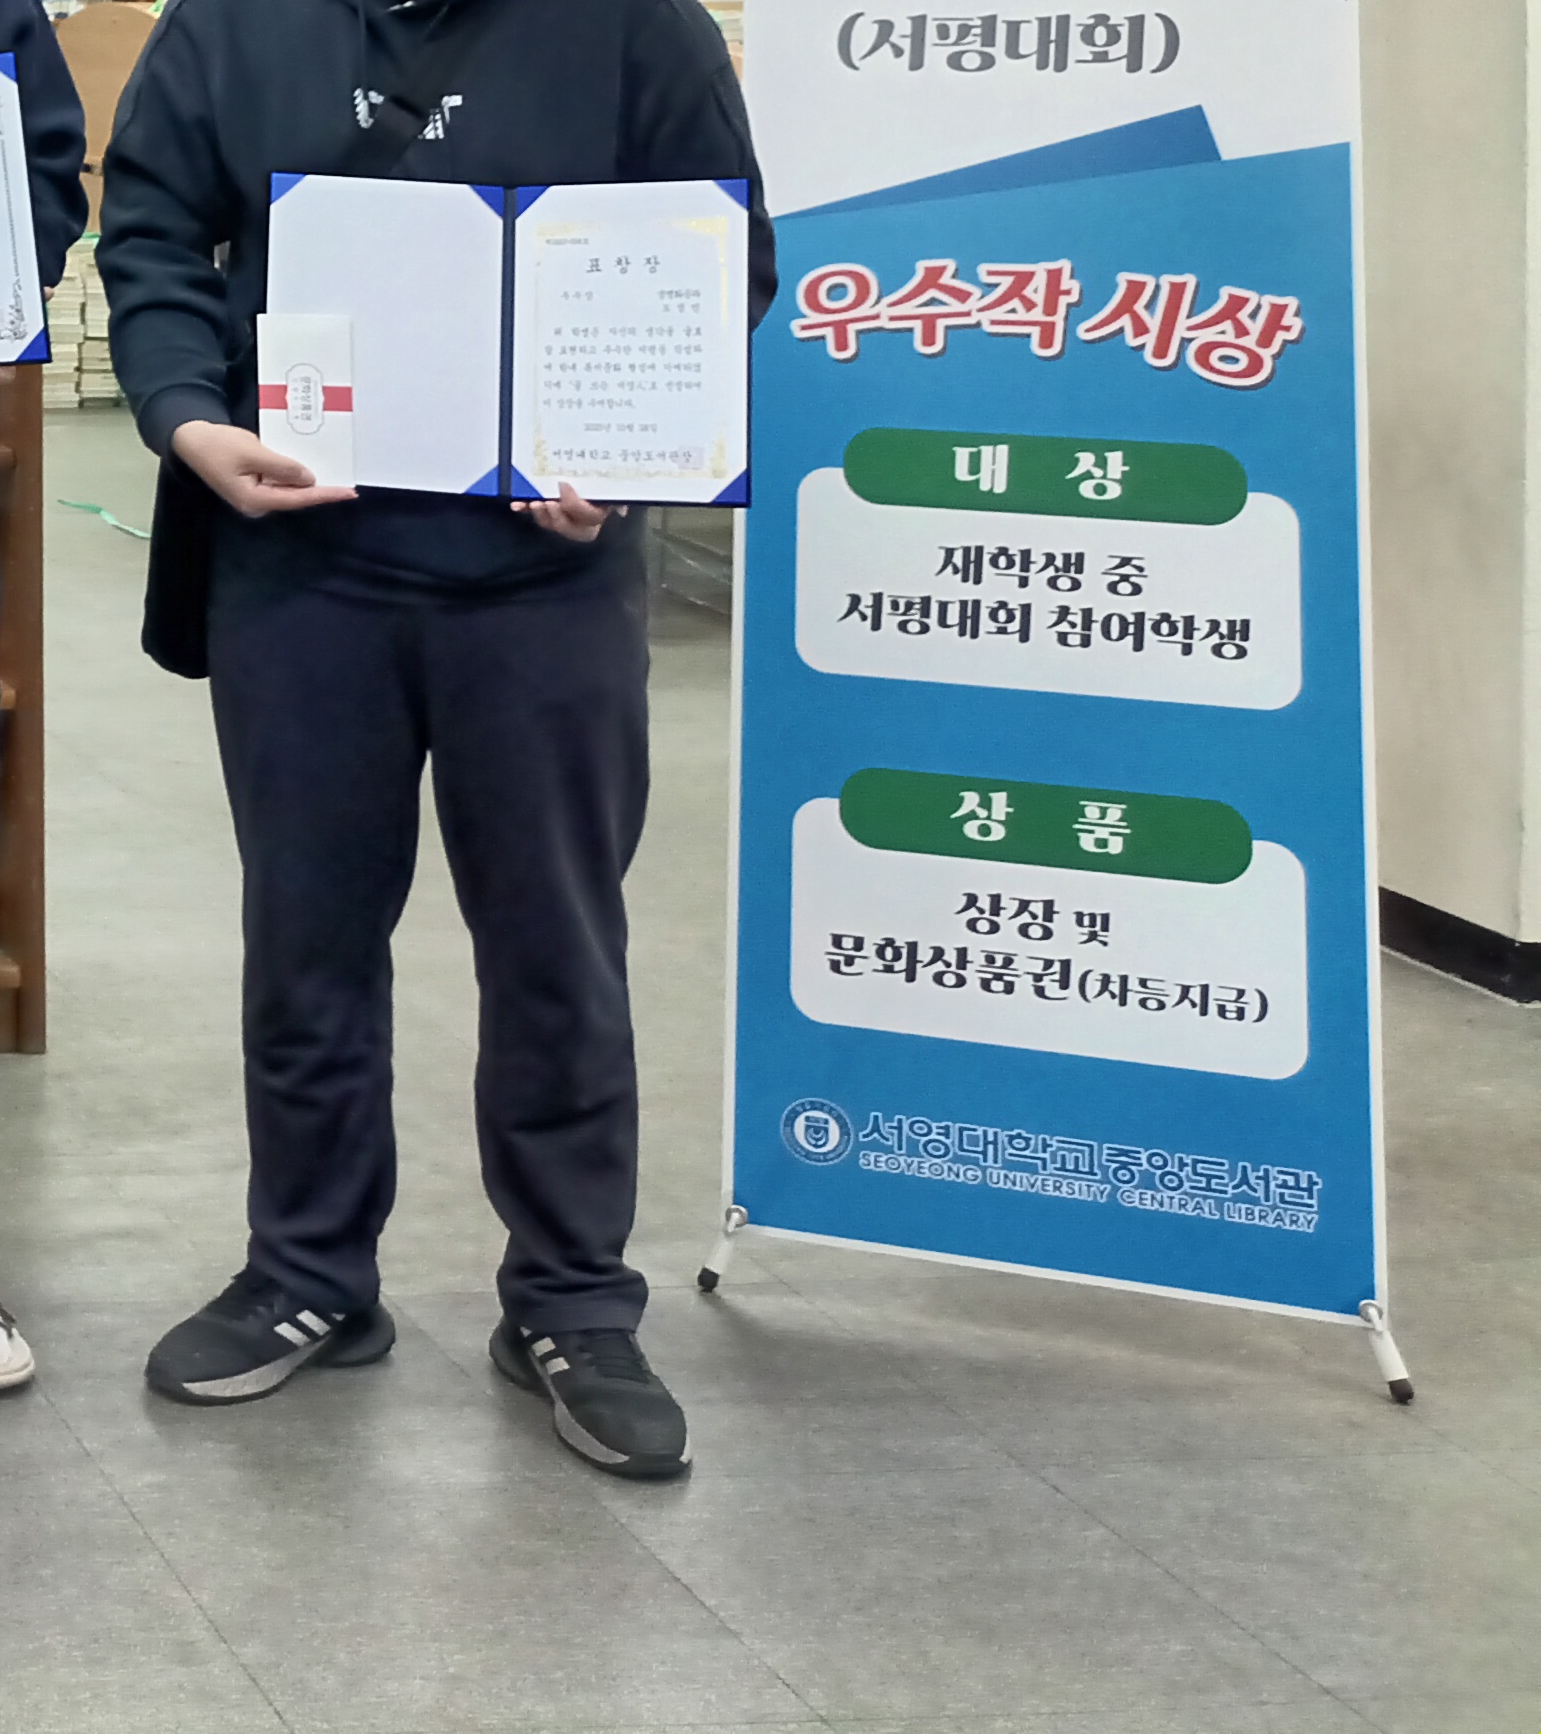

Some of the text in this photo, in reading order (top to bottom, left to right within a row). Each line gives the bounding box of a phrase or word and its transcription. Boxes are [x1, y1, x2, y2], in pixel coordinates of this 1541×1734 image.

[837, 11, 1180, 74] (서평대회)
[792, 259, 1303, 387] 우수작 시상
[935, 544, 1148, 596] 재학생 중
[836, 591, 1252, 660] 서평대회 참여학생
[954, 892, 1111, 947] 상장 및
[859, 1111, 1101, 1179] 서영대학교
[1103, 1143, 1323, 1210] 중앙도서관
[859, 1150, 1318, 1234] SEOYEONG UNIVERSITY CENTRAL LIBRARY
